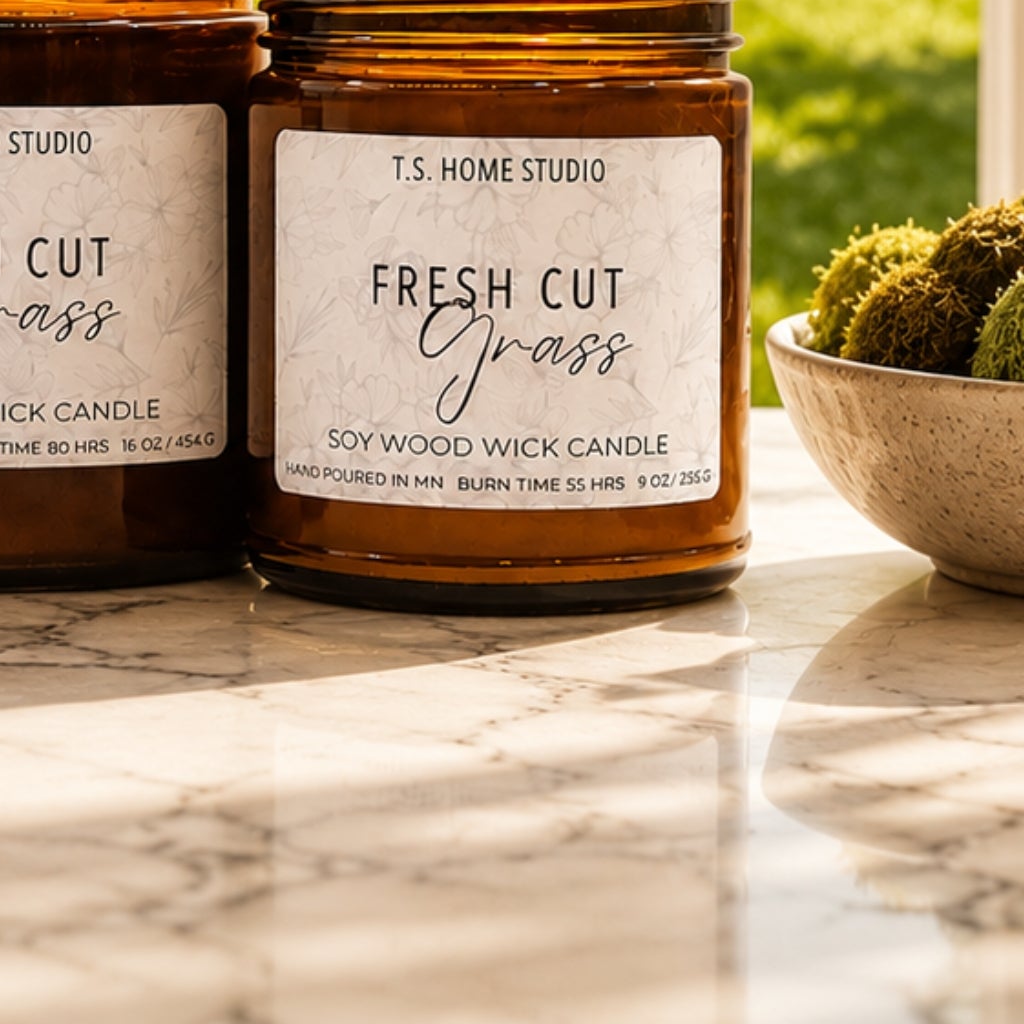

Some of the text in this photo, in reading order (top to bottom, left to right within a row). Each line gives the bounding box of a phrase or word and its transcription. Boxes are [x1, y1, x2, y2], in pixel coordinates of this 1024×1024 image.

[8, 131, 92, 154] STUDIO
[393, 157, 605, 182] T.S. HOME STUDIO
[27, 237, 109, 277] CUT
[372, 265, 624, 309] FRESH CUT
[55, 400, 160, 421] CANDLE
[0, 442, 41, 455] TIME
[47, 441, 69, 455] 80
[75, 440, 109, 454] HRS
[122, 439, 137, 452] 16
[328, 429, 668, 457] SOY WOOD WICK CANDLE
[285, 462, 320, 480] HAND
[324, 467, 386, 486] POURED
[392, 474, 409, 488] IN
[415, 475, 443, 488] MN
[458, 476, 510, 491] BURN
[516, 477, 560, 492] TIME
[566, 477, 585, 491] 55
[591, 476, 625, 490] HRS
[638, 474, 647, 488] 9
